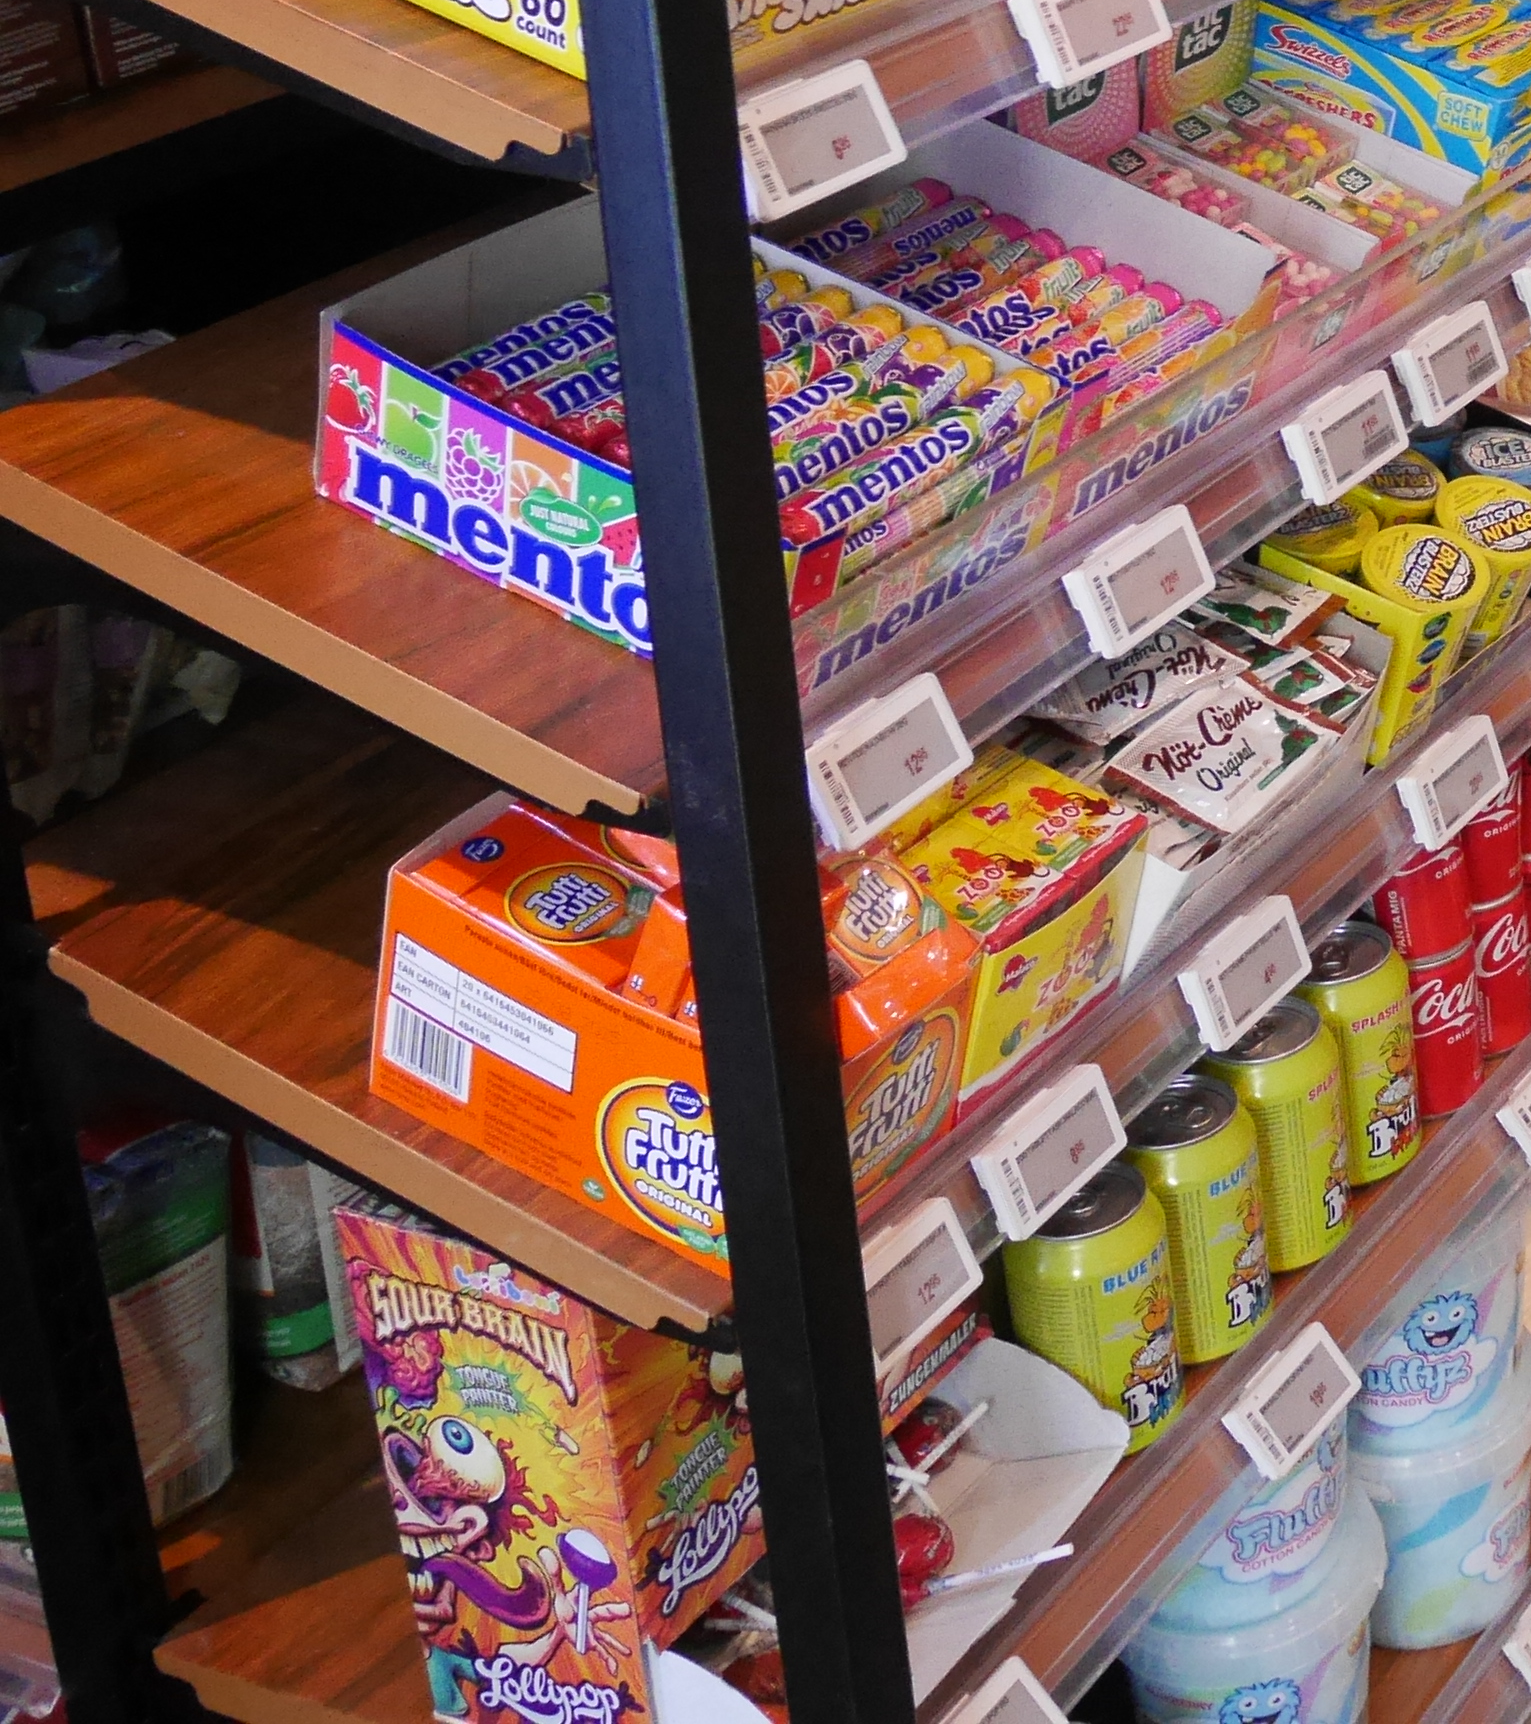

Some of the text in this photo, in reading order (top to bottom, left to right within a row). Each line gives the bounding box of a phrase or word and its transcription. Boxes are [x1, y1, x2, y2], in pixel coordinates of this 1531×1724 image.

[516, 15, 566, 49] count
[1441, 108, 1485, 133] CHEW
[1444, 97, 1484, 118] SOFT
[1073, 376, 1254, 517] mentos
[813, 419, 972, 530] mentos
[1465, 502, 1526, 530] BLASTERZ
[1404, 538, 1439, 592] BLASTERZ
[1424, 540, 1461, 597] BRAIN
[1197, 742, 1256, 794] Original
[634, 1179, 713, 1228] ORIGINAL
[1208, 1162, 1248, 1197] BLUE
[1102, 1257, 1149, 1295] BLUE
[366, 1273, 580, 1406] SOUR BRAIN
[475, 1654, 620, 1724] Lollipop
